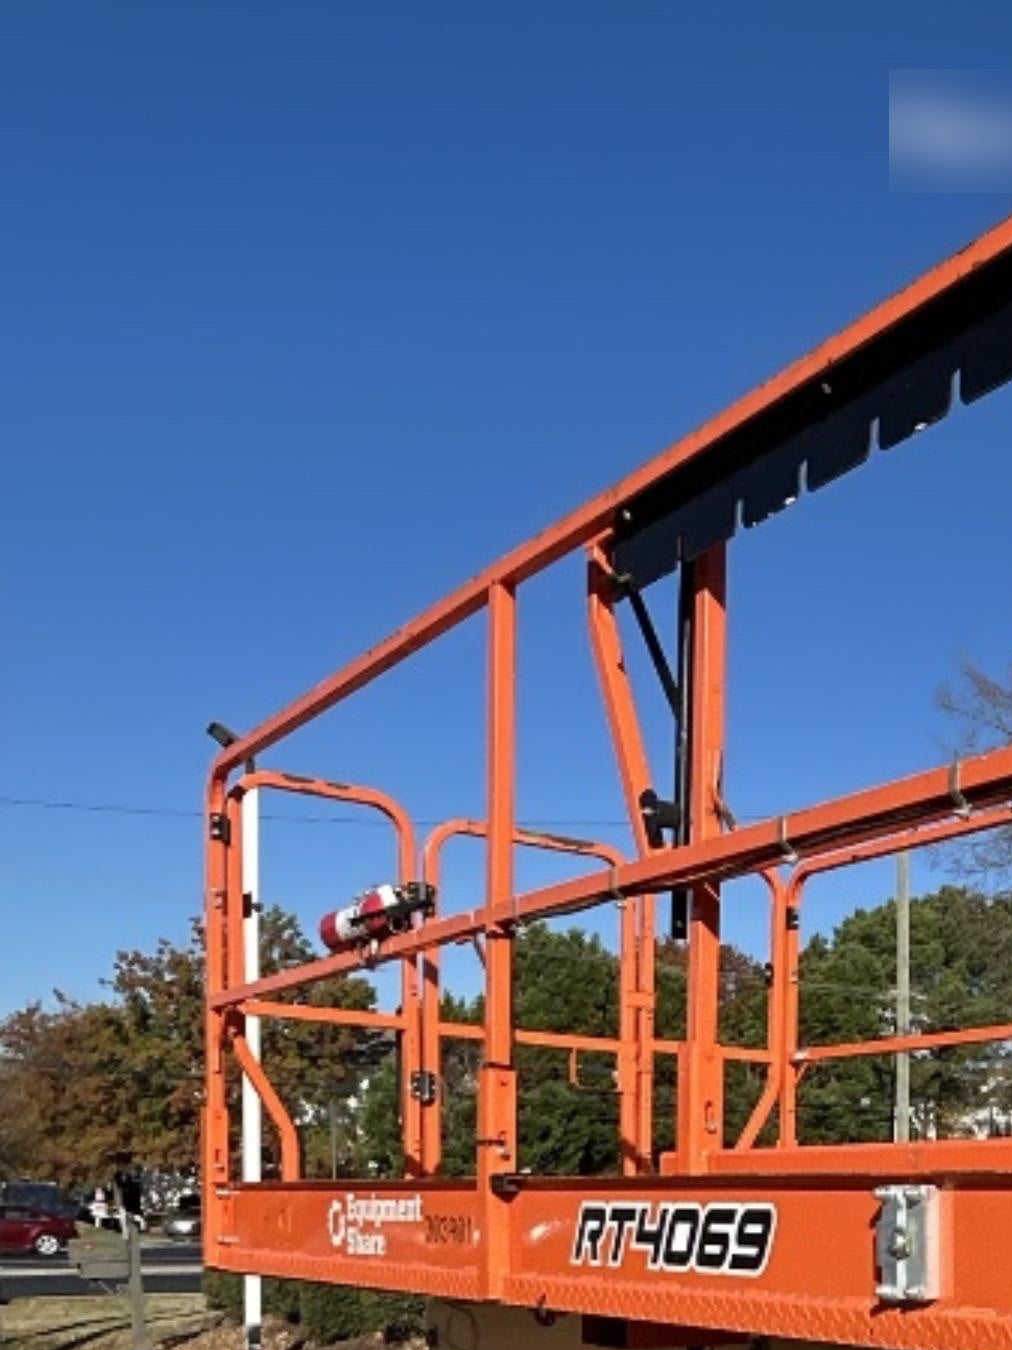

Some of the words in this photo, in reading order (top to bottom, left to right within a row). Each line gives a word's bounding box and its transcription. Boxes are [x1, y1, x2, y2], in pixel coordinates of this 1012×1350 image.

[346, 1192, 423, 1228] Equipment
[346, 1226, 387, 1255] Share
[570, 1201, 777, 1277] RT4069
